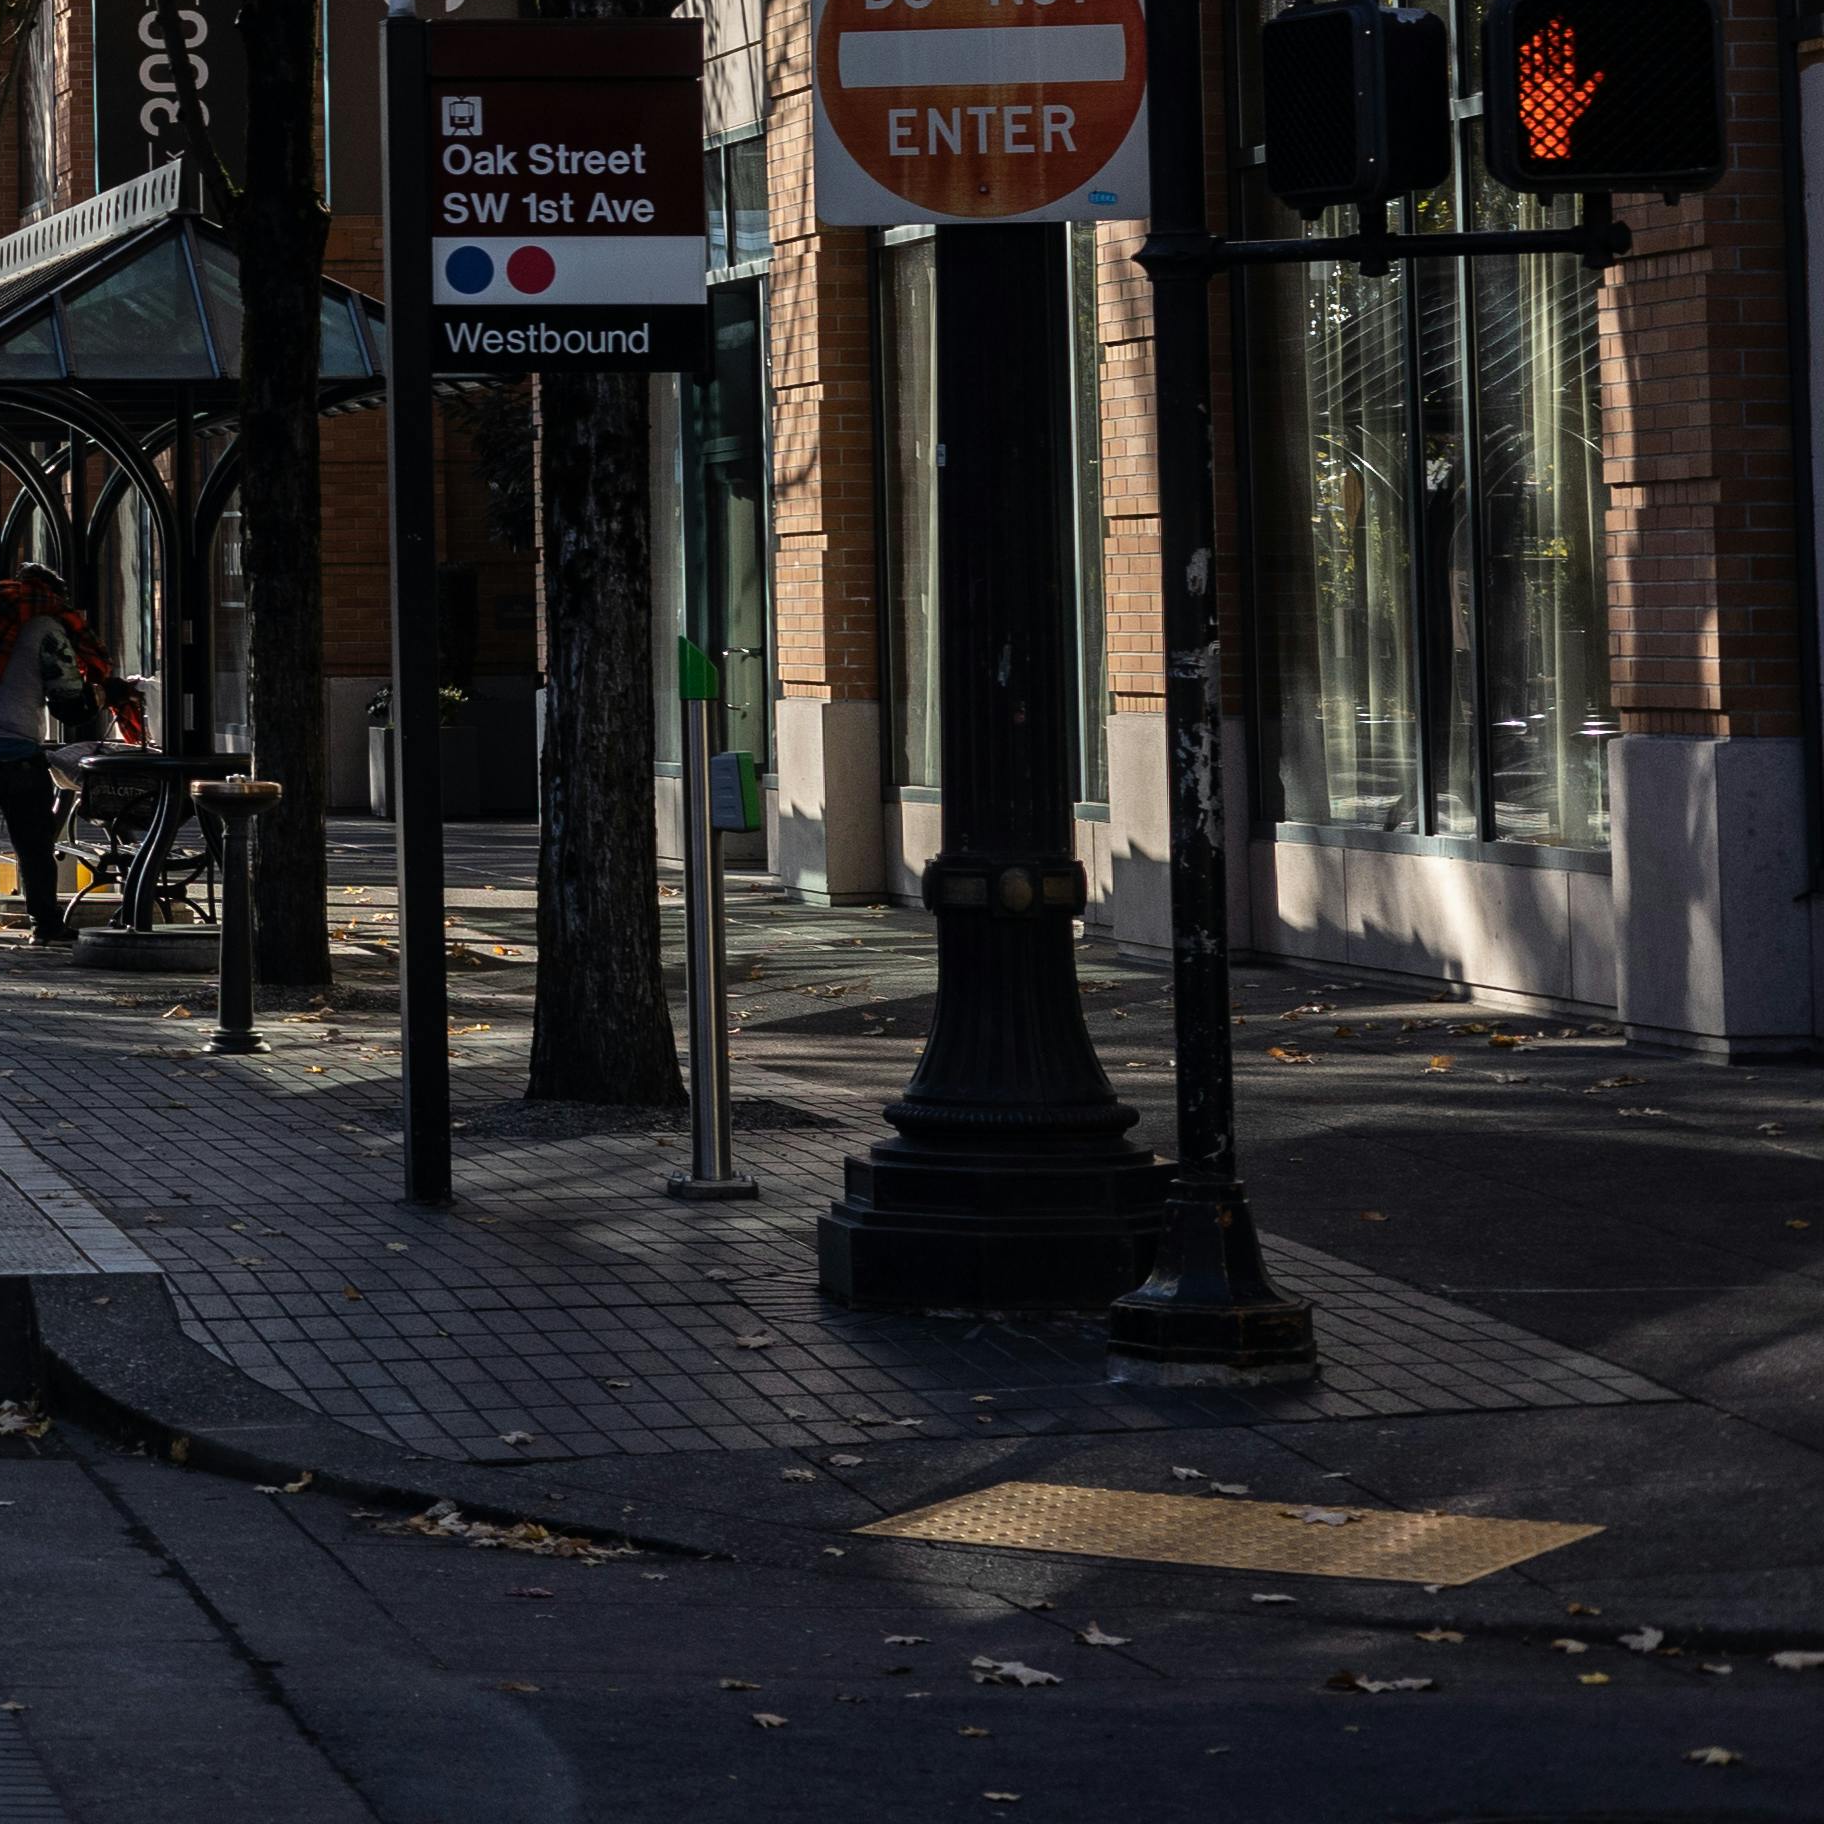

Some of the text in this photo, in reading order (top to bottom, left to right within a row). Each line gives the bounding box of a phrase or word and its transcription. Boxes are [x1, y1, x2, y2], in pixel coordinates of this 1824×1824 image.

[888, 105, 1077, 156] ENTER
[442, 143, 647, 175] Oak Street
[443, 192, 655, 224] SW 1st Ave
[444, 322, 649, 353] Westbound
